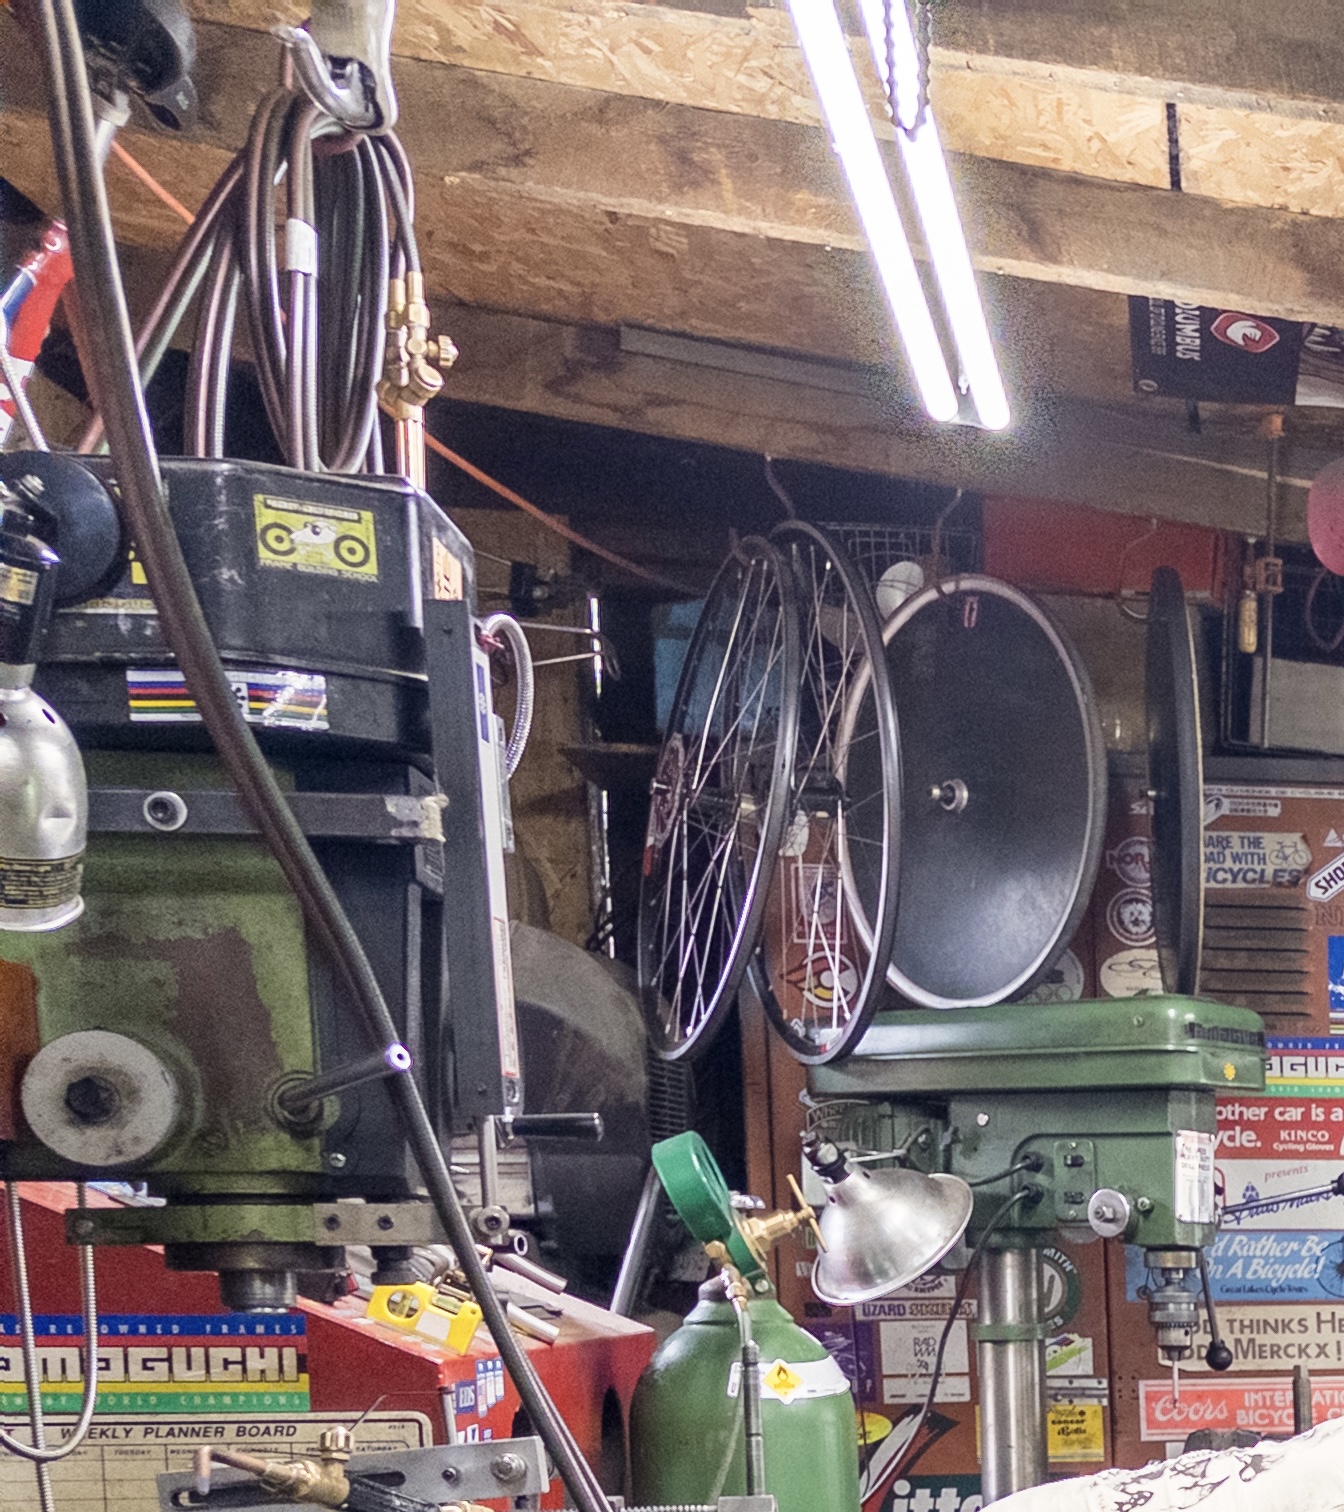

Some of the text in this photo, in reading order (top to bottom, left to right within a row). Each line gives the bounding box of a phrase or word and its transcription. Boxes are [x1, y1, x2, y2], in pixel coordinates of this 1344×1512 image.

[1238, 835, 1265, 850] THE
[1229, 852, 1267, 866] WITH
[1216, 1104, 1344, 1121] other car is a
[1213, 1127, 1262, 1148] ycle.
[1280, 1130, 1329, 1142] KINCO
[1273, 1142, 1303, 1152] Cycling
[1264, 1164, 1309, 1182] presents
[1229, 1235, 1299, 1258] Rather
[1300, 1235, 1328, 1257] Be
[1226, 1260, 1247, 1279] A
[1251, 1257, 1326, 1287] Bicycle!
[205, 1324, 298, 1334] FRAMES
[1226, 1318, 1308, 1334] THINKS
[0, 1347, 298, 1382] AMAGUCHI
[1155, 1396, 1228, 1421] Coors
[1236, 1408, 1317, 1425] BICYCE
[143, 1426, 224, 1438] PLANNER
[236, 1426, 297, 1437] BOARD
